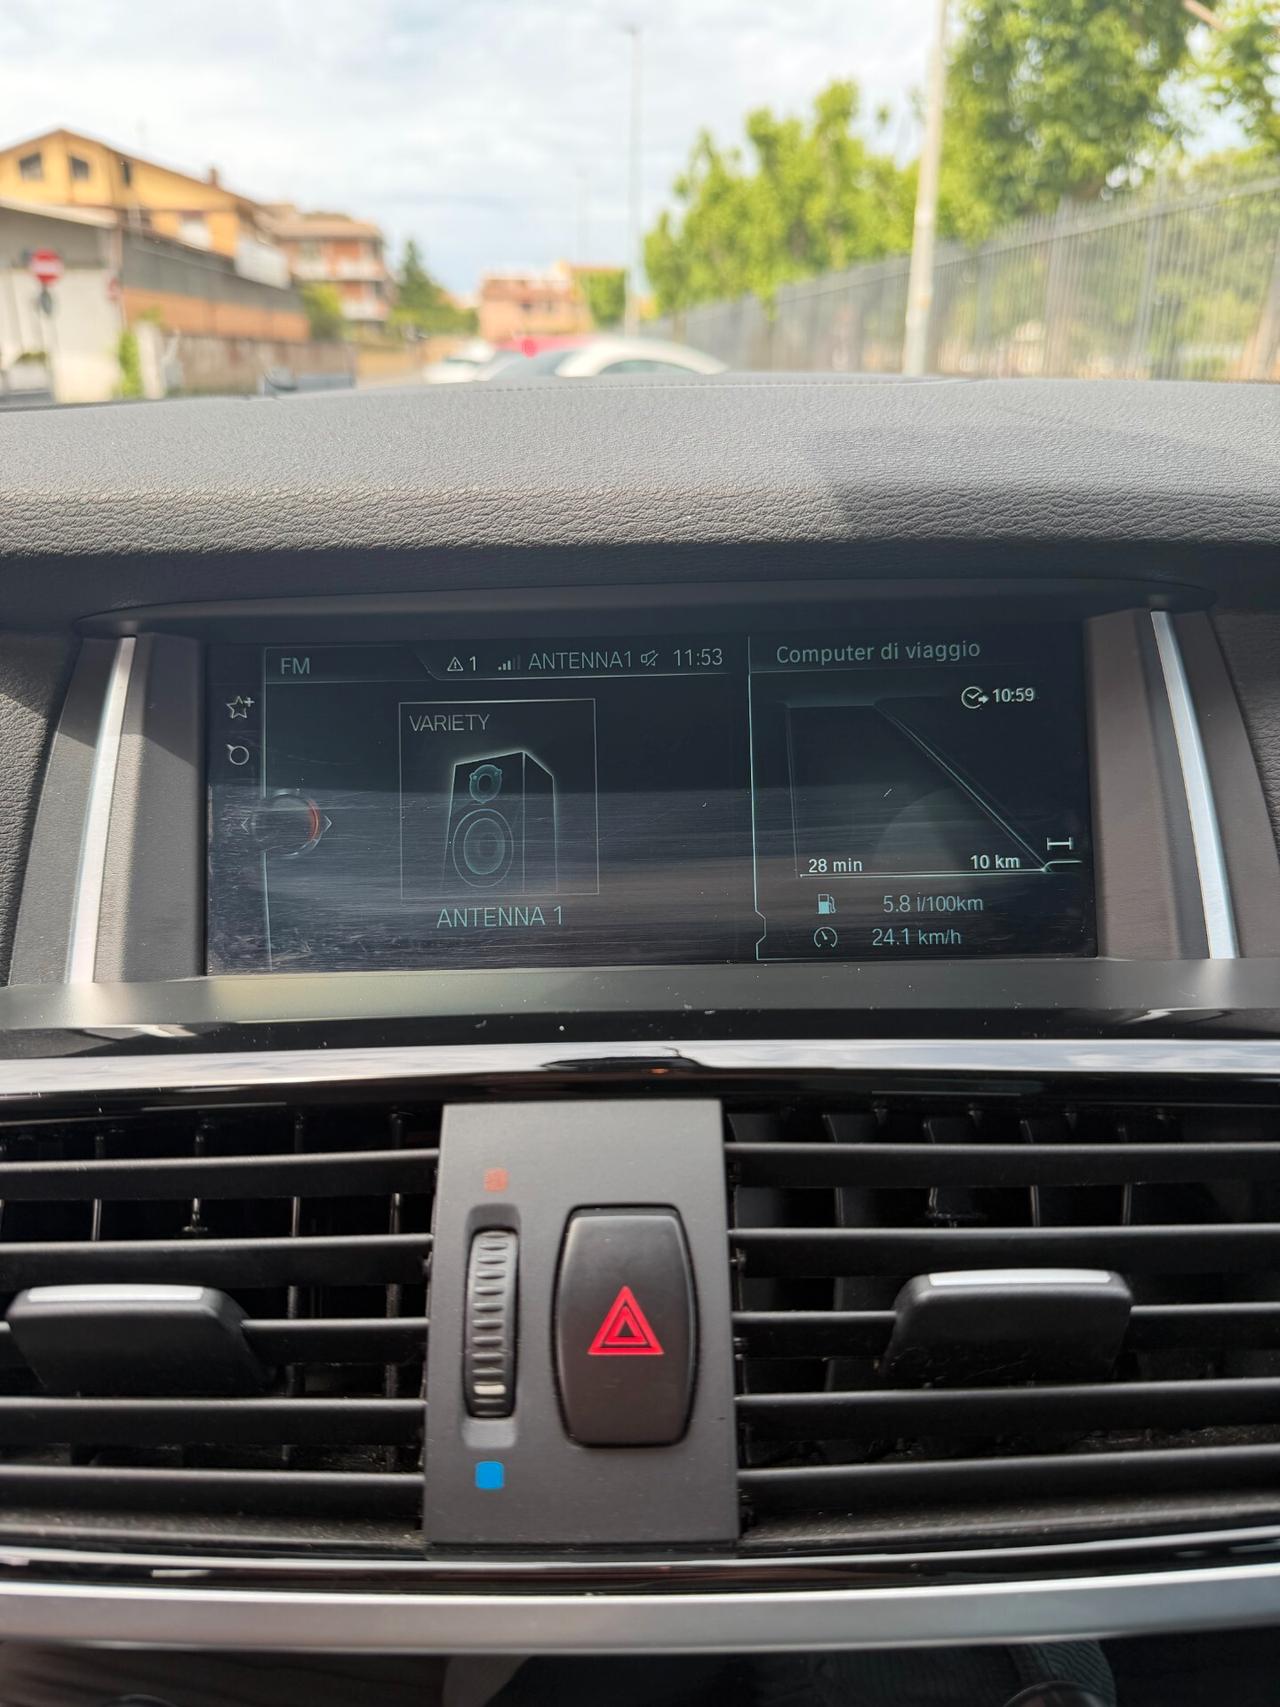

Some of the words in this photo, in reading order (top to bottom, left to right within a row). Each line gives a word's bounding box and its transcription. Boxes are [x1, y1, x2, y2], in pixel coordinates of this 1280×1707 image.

[673, 648, 724, 667] 11:53
[776, 644, 875, 665] Computer
[880, 642, 900, 660] di
[905, 640, 981, 662] viaggio
[280, 657, 310, 675] FM
[469, 656, 478, 671] 1
[992, 687, 1035, 703] 10:59
[409, 714, 490, 732] VARIETY
[808, 858, 828, 873] 28
[833, 858, 863, 872] min
[970, 855, 990, 870] 10
[995, 855, 1020, 869] km
[883, 895, 911, 913] 5.8
[436, 906, 546, 929] ANTENNA
[553, 905, 563, 926] 1
[872, 928, 910, 946] 24.1
[918, 928, 962, 945] km/h
